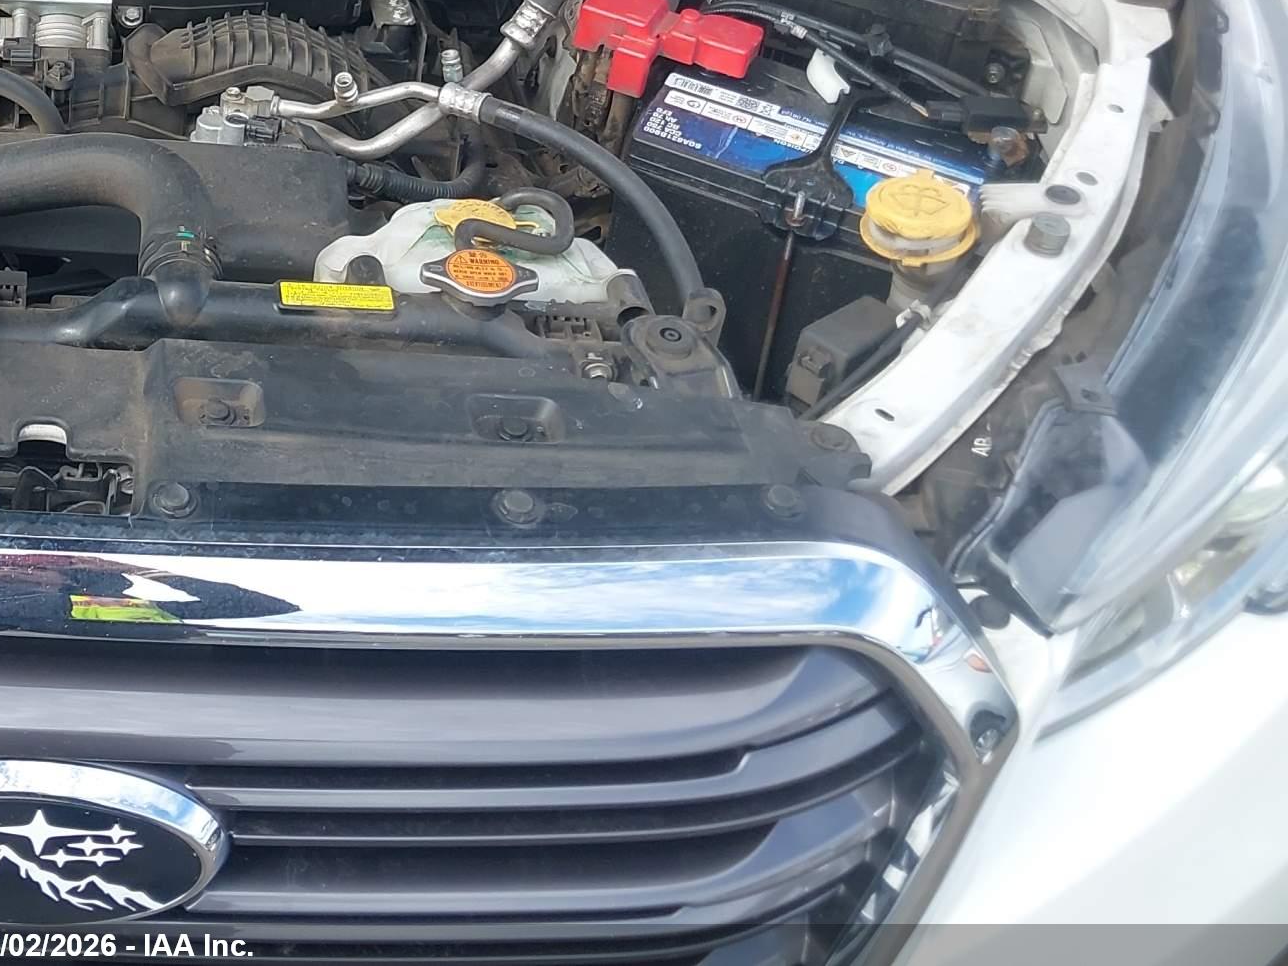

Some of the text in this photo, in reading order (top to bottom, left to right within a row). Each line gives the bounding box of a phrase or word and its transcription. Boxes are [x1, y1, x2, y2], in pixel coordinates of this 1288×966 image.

[652, 112, 663, 120] 70
[649, 116, 665, 125] 120
[665, 127, 683, 137] CCA
[470, 257, 500, 265] WARNING
